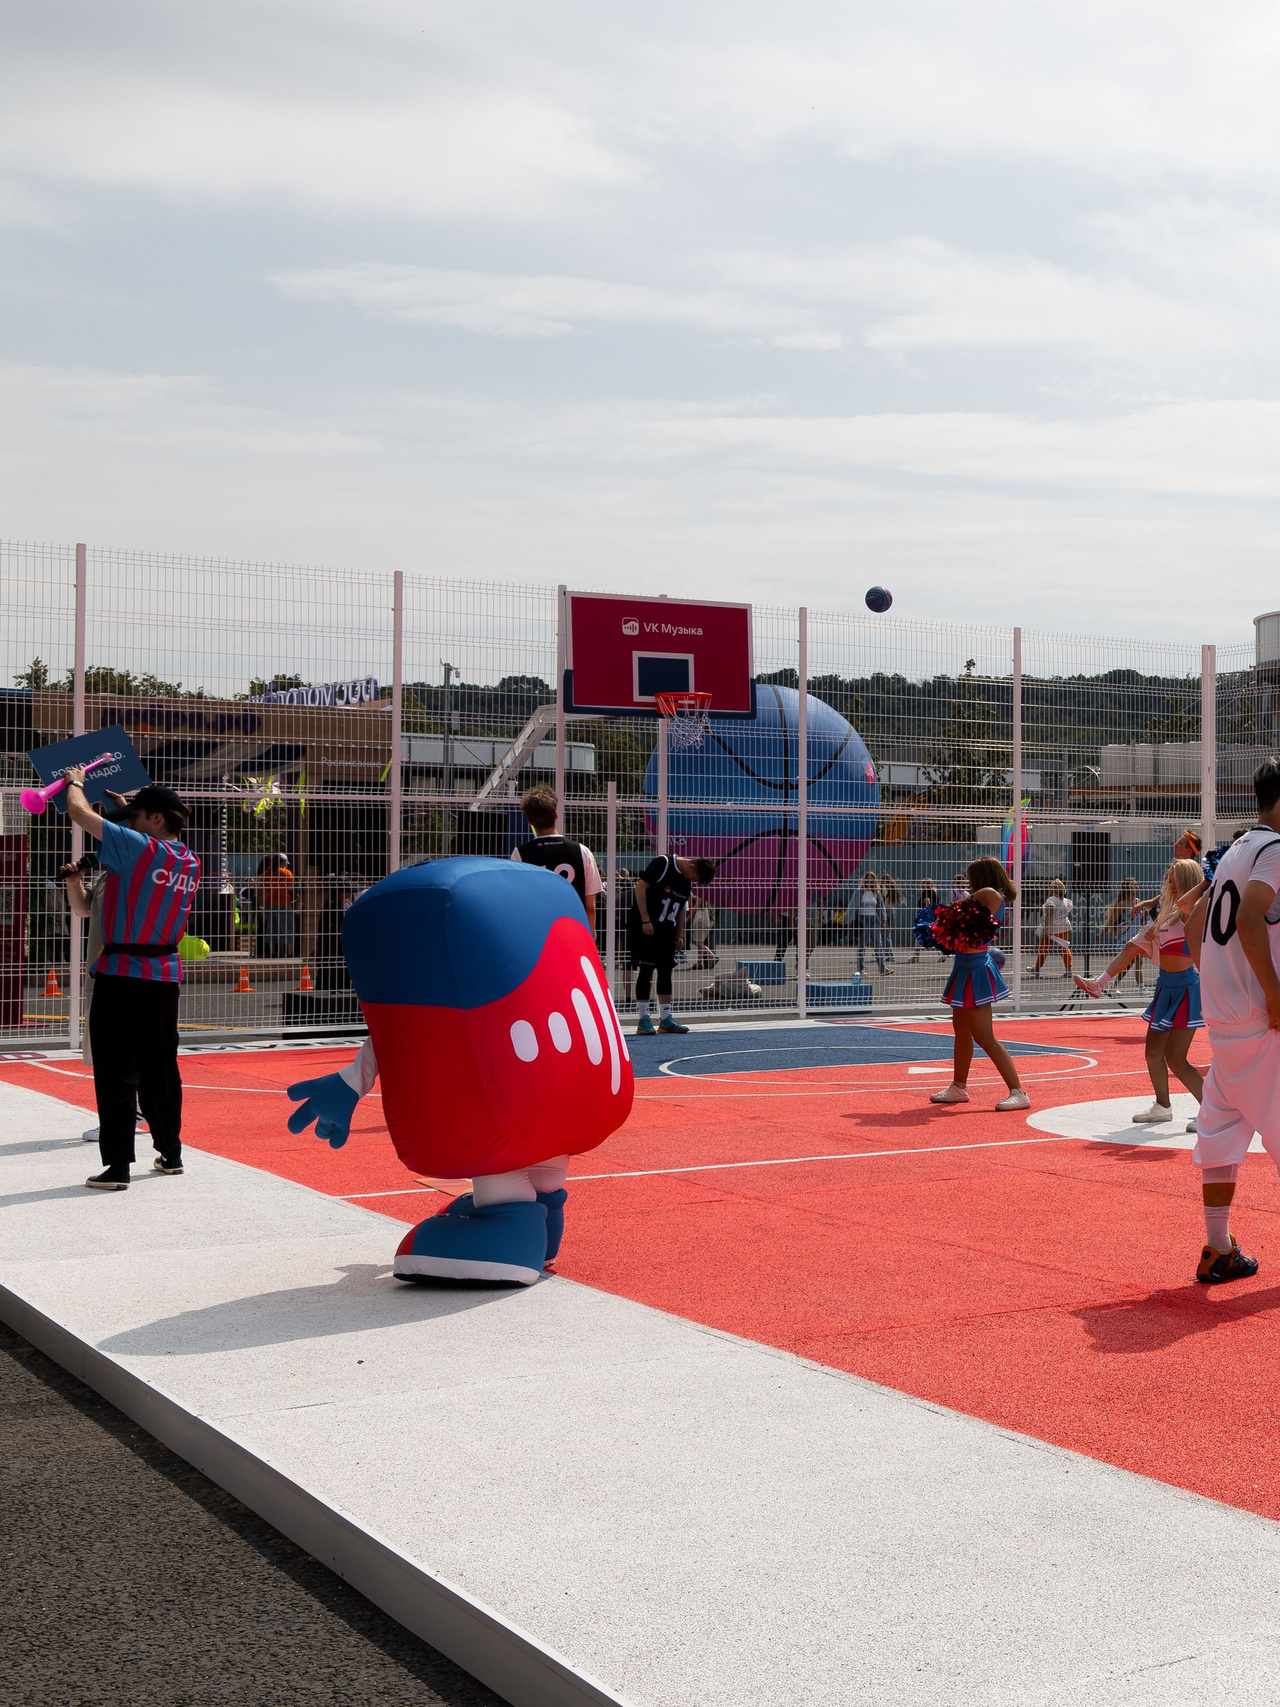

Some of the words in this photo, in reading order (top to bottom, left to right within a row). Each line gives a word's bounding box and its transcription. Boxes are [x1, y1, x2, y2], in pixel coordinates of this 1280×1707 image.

[643, 622, 660, 633] VK
[661, 623, 703, 636] Музыка
[321, 756, 382, 769] Расписание
[88, 763, 122, 780] НАДО!
[151, 868, 201, 895] СУДЬ
[1202, 879, 1241, 946] 10
